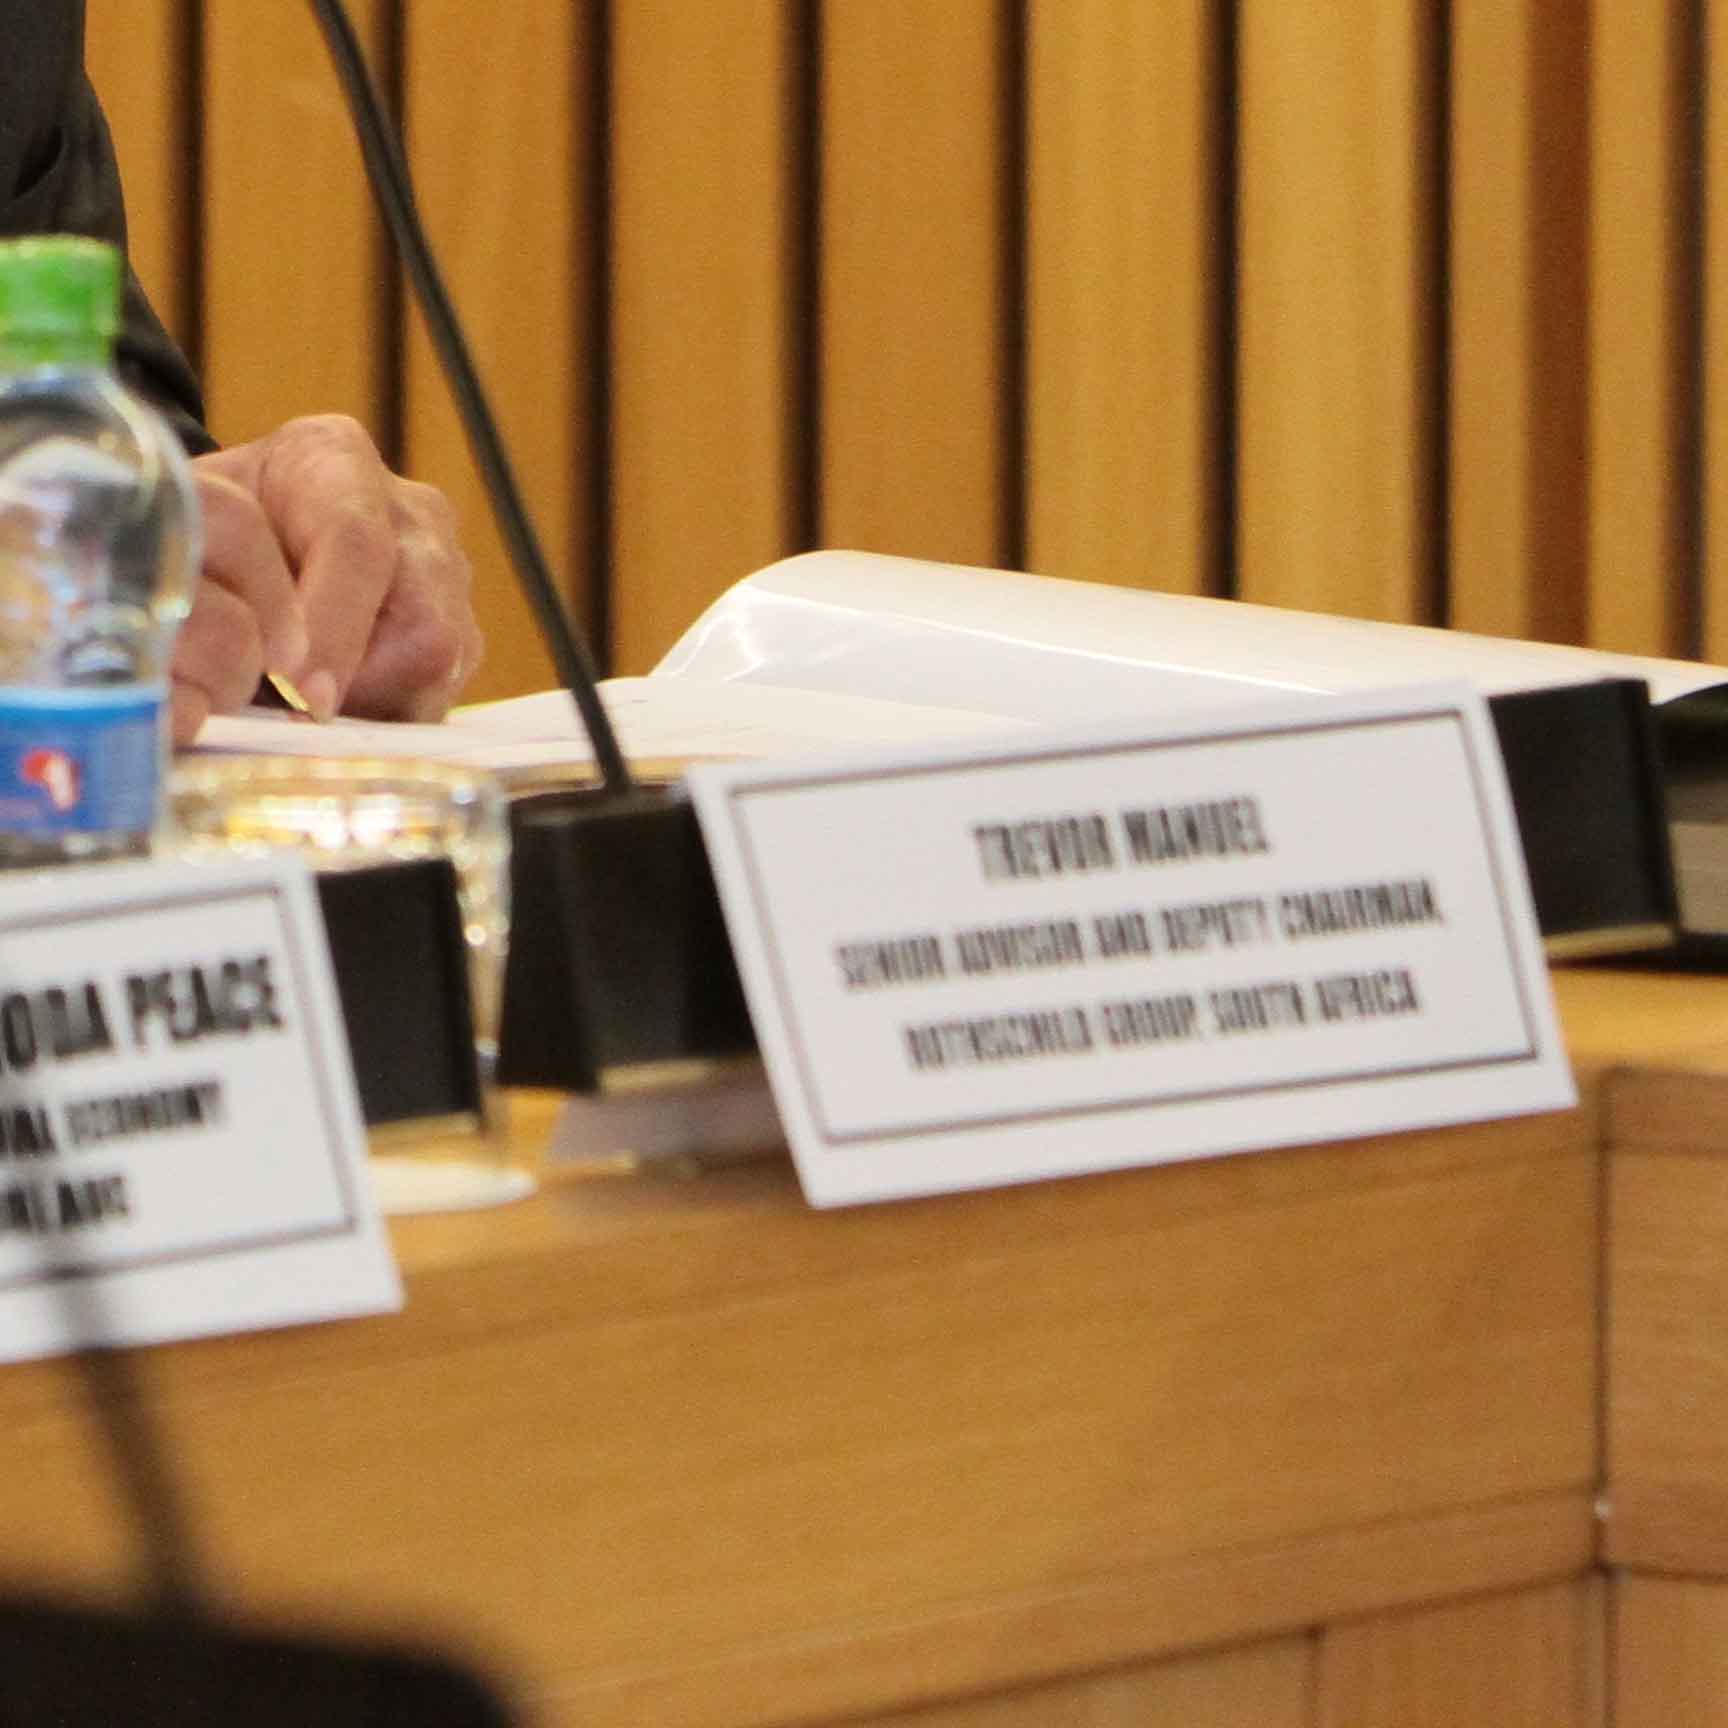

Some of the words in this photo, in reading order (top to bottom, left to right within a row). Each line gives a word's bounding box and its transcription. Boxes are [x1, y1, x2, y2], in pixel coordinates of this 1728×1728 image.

[972, 810, 1117, 884] TREVOR
[1121, 795, 1271, 866] MANUEL
[837, 934, 946, 990] SENIOR
[953, 919, 1086, 978] ADVISOR
[1094, 909, 1153, 960] AND
[1161, 894, 1273, 956] DEPUTY
[124, 952, 287, 1050] PEACE
[1208, 977, 1308, 1038] SOUTH
[1312, 967, 1424, 1025] AFRICA
